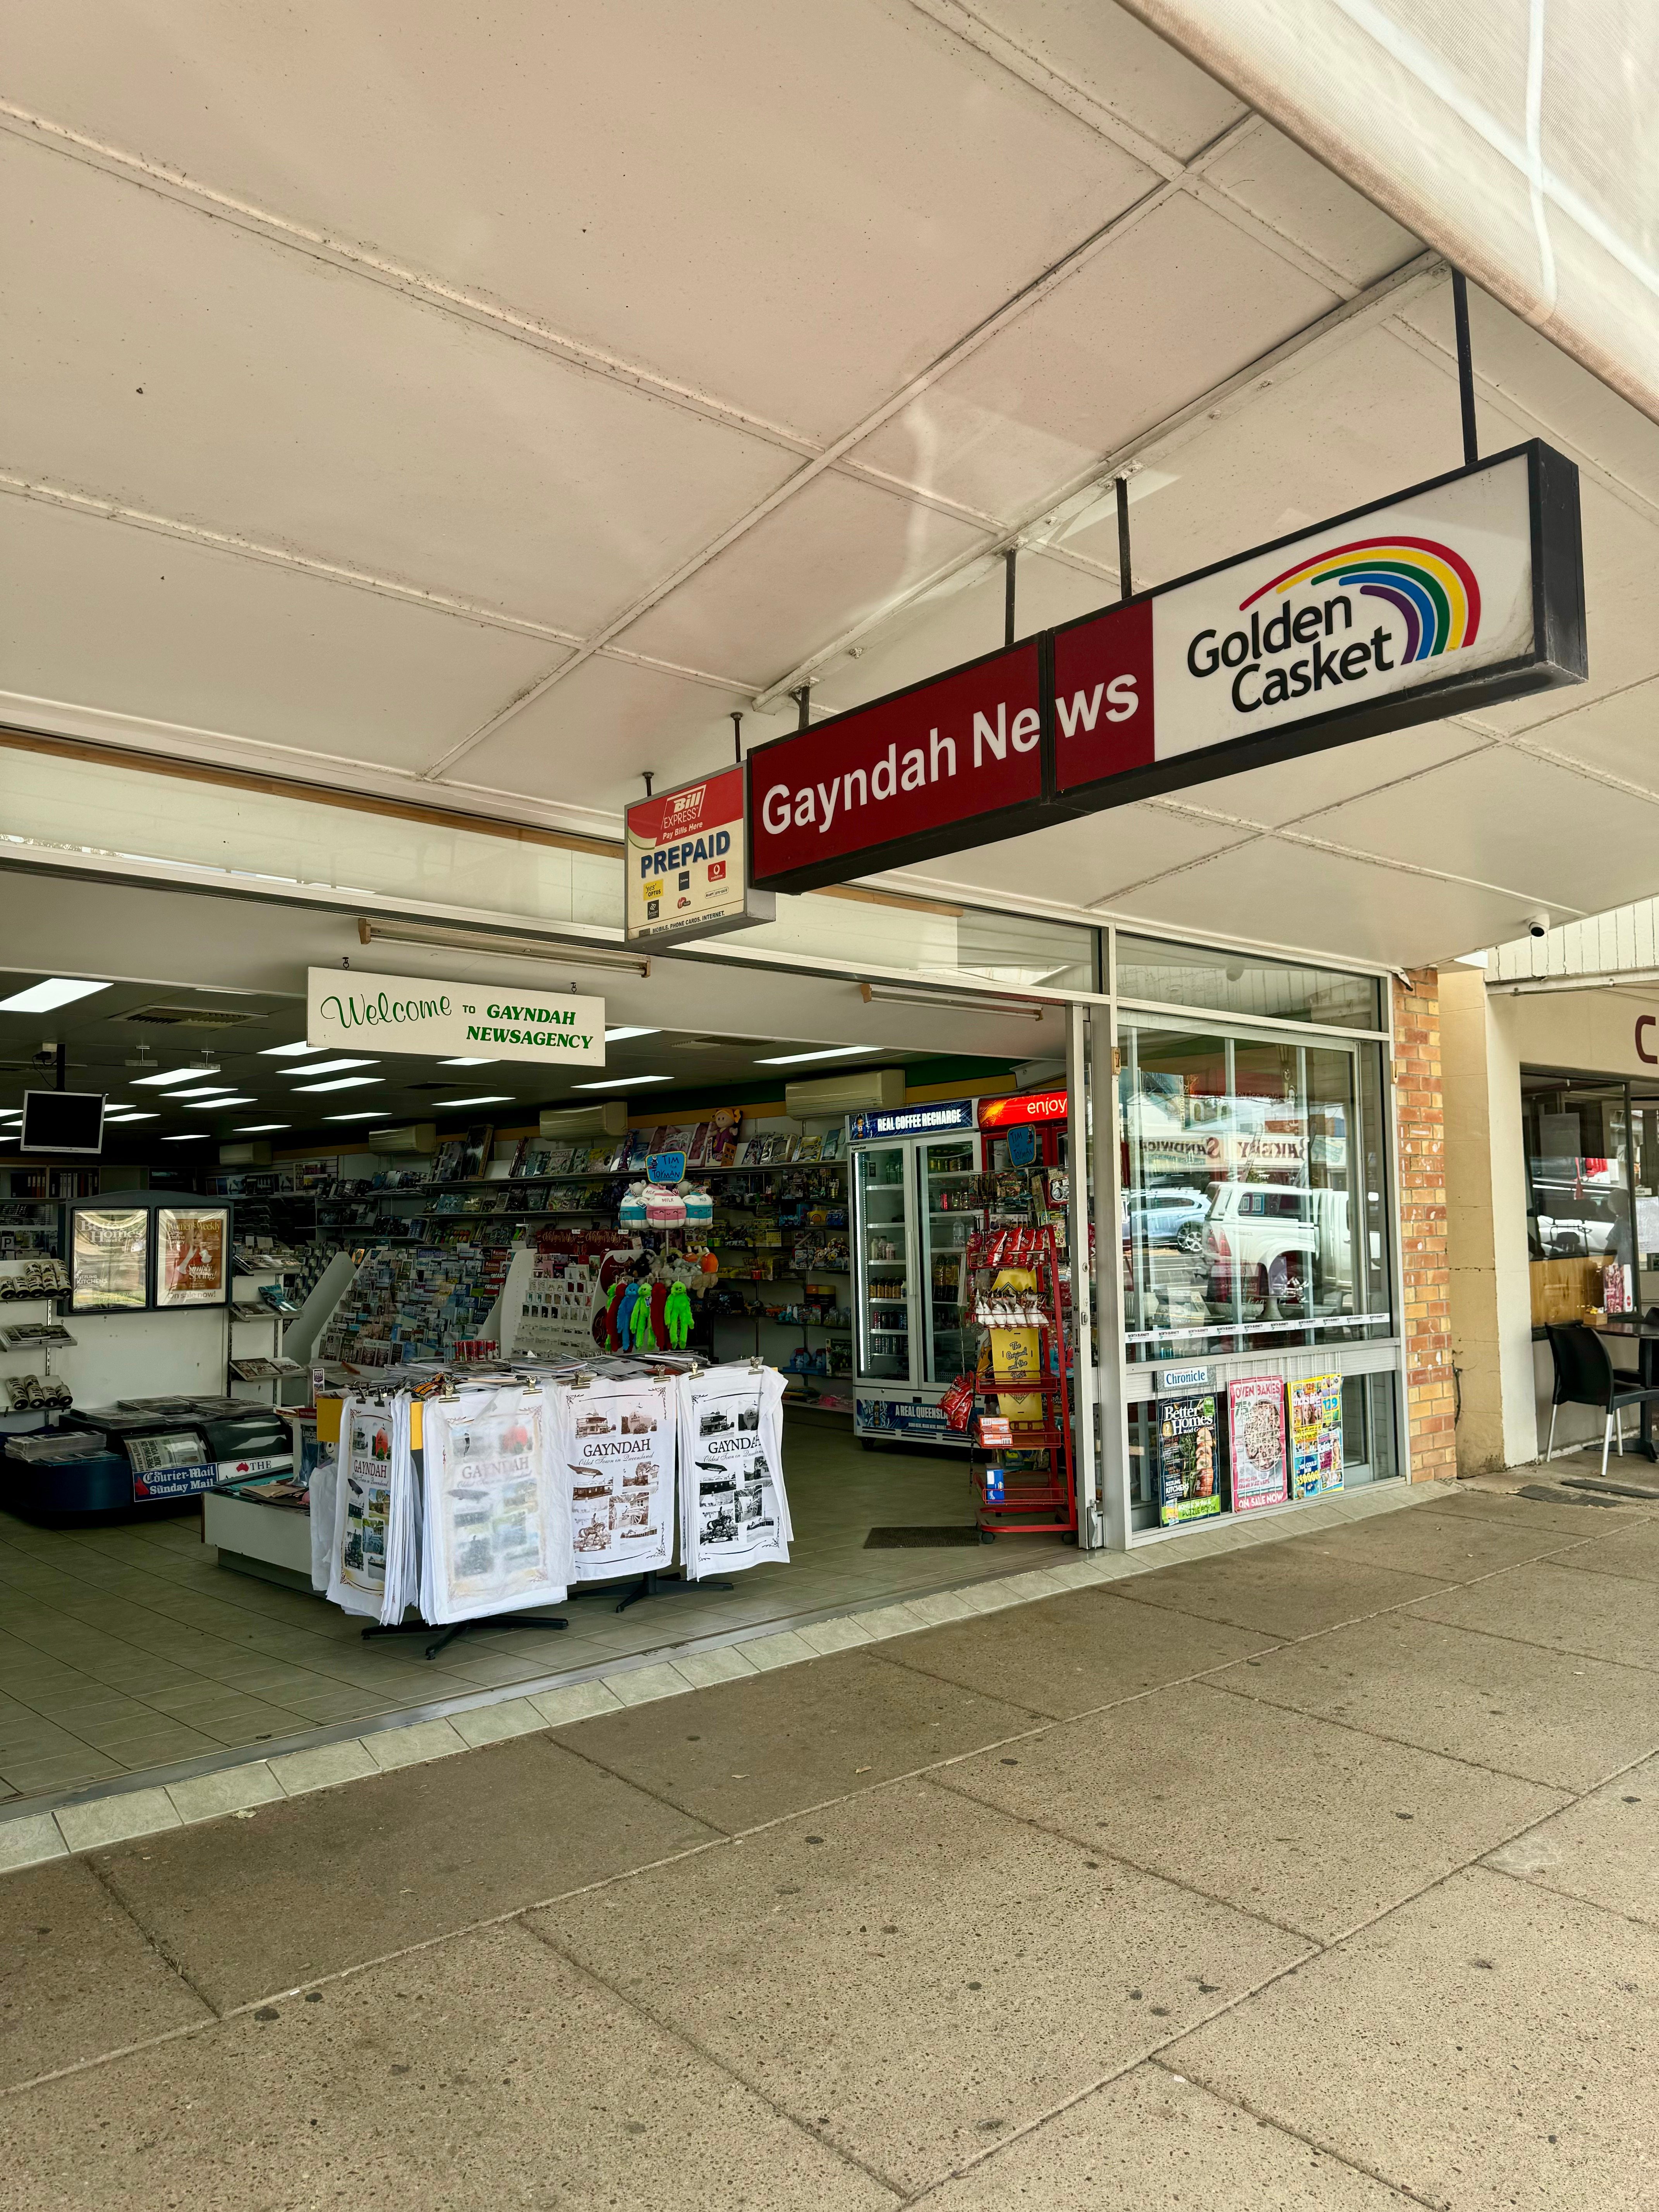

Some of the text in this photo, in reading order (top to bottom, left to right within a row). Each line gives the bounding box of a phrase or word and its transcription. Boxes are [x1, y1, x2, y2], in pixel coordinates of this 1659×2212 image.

[1187, 595, 1352, 678] Golden
[1232, 626, 1394, 713] Casket
[762, 674, 1139, 834] Gayndah News
[673, 791, 701, 813] Bill
[664, 807, 697, 829] EXPRESS
[663, 821, 703, 840] Pay Bills Here
[641, 830, 731, 878] PREPAID
[702, 910, 725, 921] INTERNET.
[321, 992, 576, 1029] Welcome TO GAYNDAH
[466, 1026, 594, 1049] NEWSAGENCY
[1027, 1097, 1067, 1115] enjoy
[877, 1109, 962, 1132] REAL COFFEE RECHARGE
[1010, 1131, 1023, 1143] TIM
[662, 1154, 679, 1165] TIM
[1013, 1147, 1033, 1160] TOYMAN
[652, 1169, 680, 1179] TOYMAN
[197, 1222, 220, 1232] Weekly
[4, 1238, 11, 1248] P
[91, 1228, 143, 1243] Homes
[188, 1264, 212, 1273] Simply
[189, 1271, 217, 1281] Spring!
[1006, 1346, 1028, 1360] Original
[1010, 1341, 1021, 1350] The
[1008, 1360, 1018, 1370] and
[1166, 1370, 1205, 1385] Chronicle
[1236, 1383, 1280, 1398] OVEN BAKES
[895, 1405, 948, 1420] A REAL QUEENSLA
[1164, 1406, 1200, 1422] Better
[1171, 1414, 1213, 1436] Homes
[149, 1440, 161, 1467] OUR YOUNG
[583, 1438, 651, 1457] GAYNDAH
[144, 1447, 155, 1468] PREYING
[579, 1458, 594, 1466] Oldest
[594, 1456, 613, 1465] Town
[623, 1452, 654, 1462] Queensland
[720, 1452, 734, 1460] Town
[250, 1460, 271, 1471] THE
[354, 1460, 386, 1478] GAYNDAH
[143, 1465, 215, 1484] Courier-Mail
[149, 1479, 214, 1495] Sunday Mail
[1166, 1483, 1189, 1494] KITCHENS
[1178, 1503, 1194, 1511] BONUS
[1239, 1498, 1250, 1508] ON
[1251, 1495, 1266, 1506] SALE
[1266, 1492, 1284, 1503] NOW
[1182, 1504, 1216, 1517] PUZZLE BOOK
